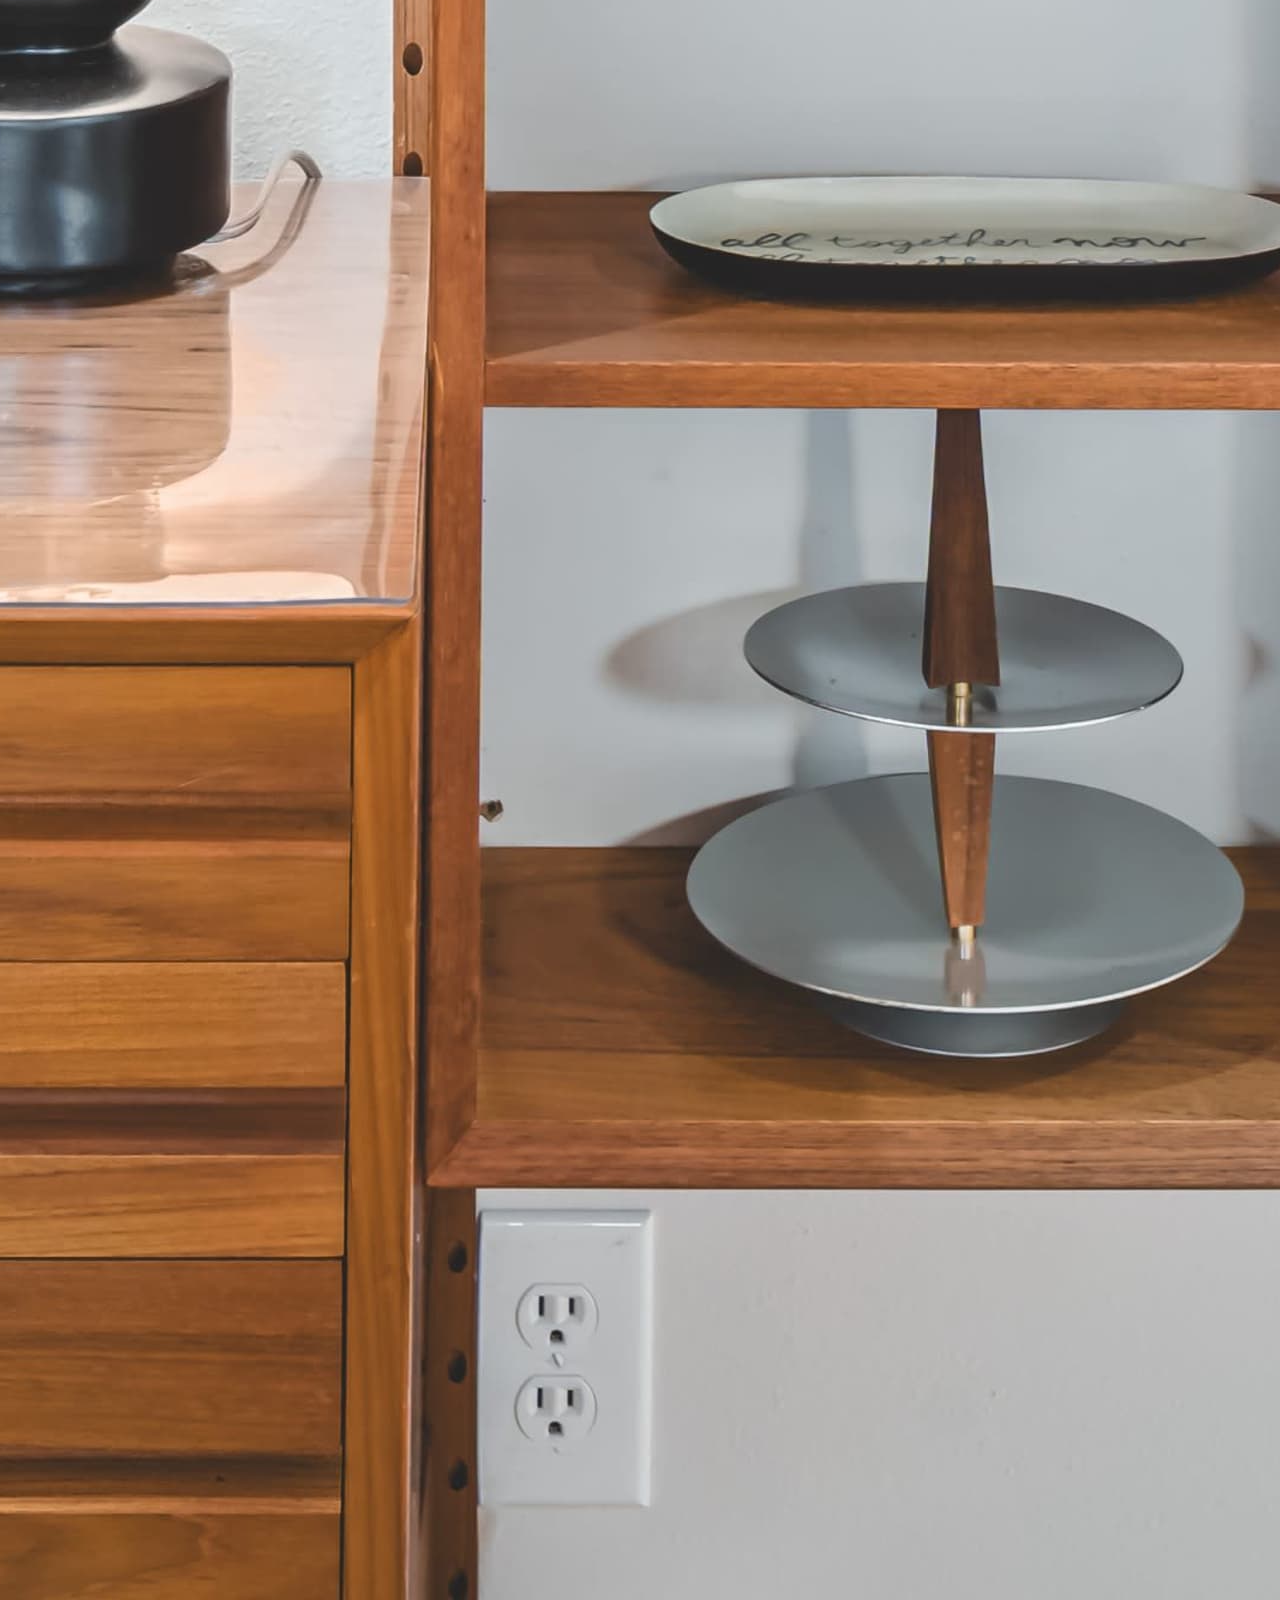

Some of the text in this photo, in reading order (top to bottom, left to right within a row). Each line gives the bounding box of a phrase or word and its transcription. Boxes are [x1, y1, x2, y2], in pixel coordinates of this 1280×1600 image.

[720, 227, 1207, 255] all together now
